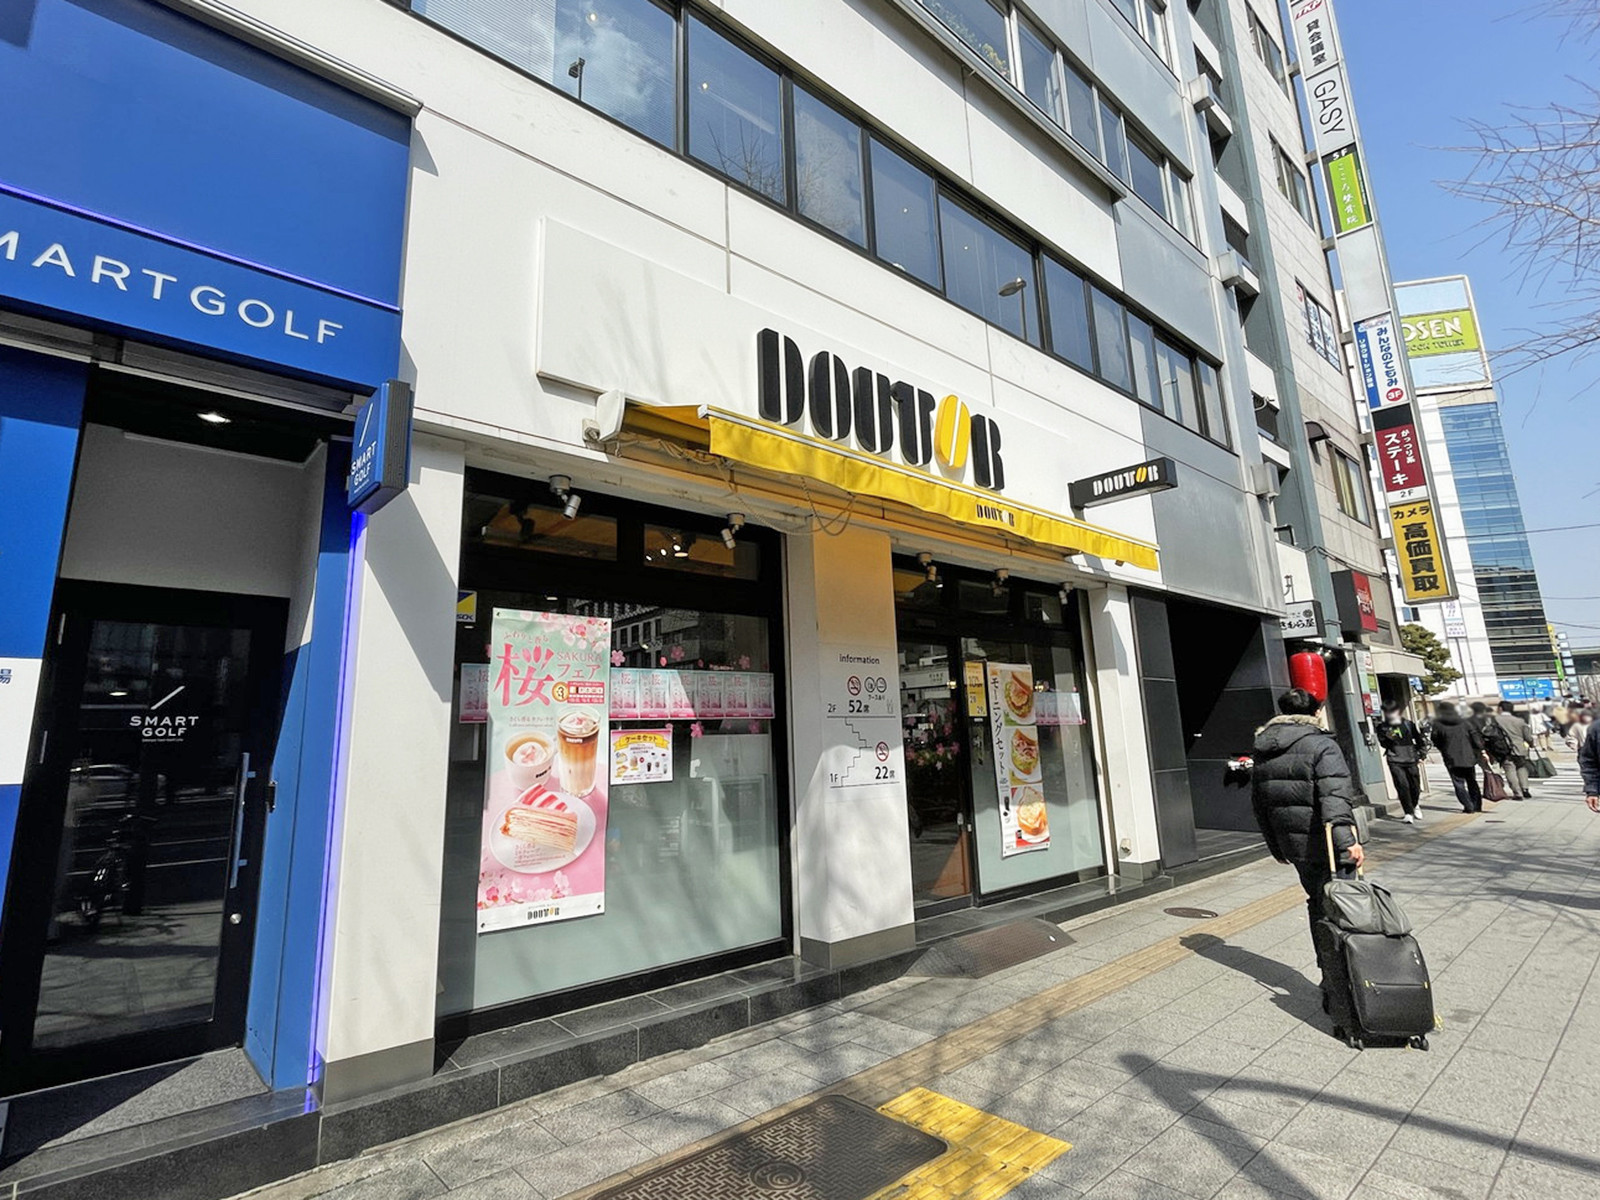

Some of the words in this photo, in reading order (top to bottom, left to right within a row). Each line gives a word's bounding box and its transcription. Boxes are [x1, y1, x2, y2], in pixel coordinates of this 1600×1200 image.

[1314, 79, 1345, 135] GASY
[190, 285, 343, 344] GOLF
[757, 327, 1005, 491] DOUTOR
[351, 440, 377, 475] SMART
[1384, 433, 1409, 486] ステーキ
[354, 461, 371, 486] GOLF
[1093, 464, 1159, 496] DOUTOR
[1393, 505, 1430, 520] カメラ
[1401, 522, 1440, 592] 高価買取
[557, 651, 603, 662] SAKURA
[839, 653, 880, 664] information
[494, 643, 554, 707] 桜
[557, 663, 601, 680] フェア
[129, 715, 199, 726] SMART
[828, 703, 837, 713] 2F
[142, 727, 187, 737] GOLF
[830, 773, 838, 783] 1F
